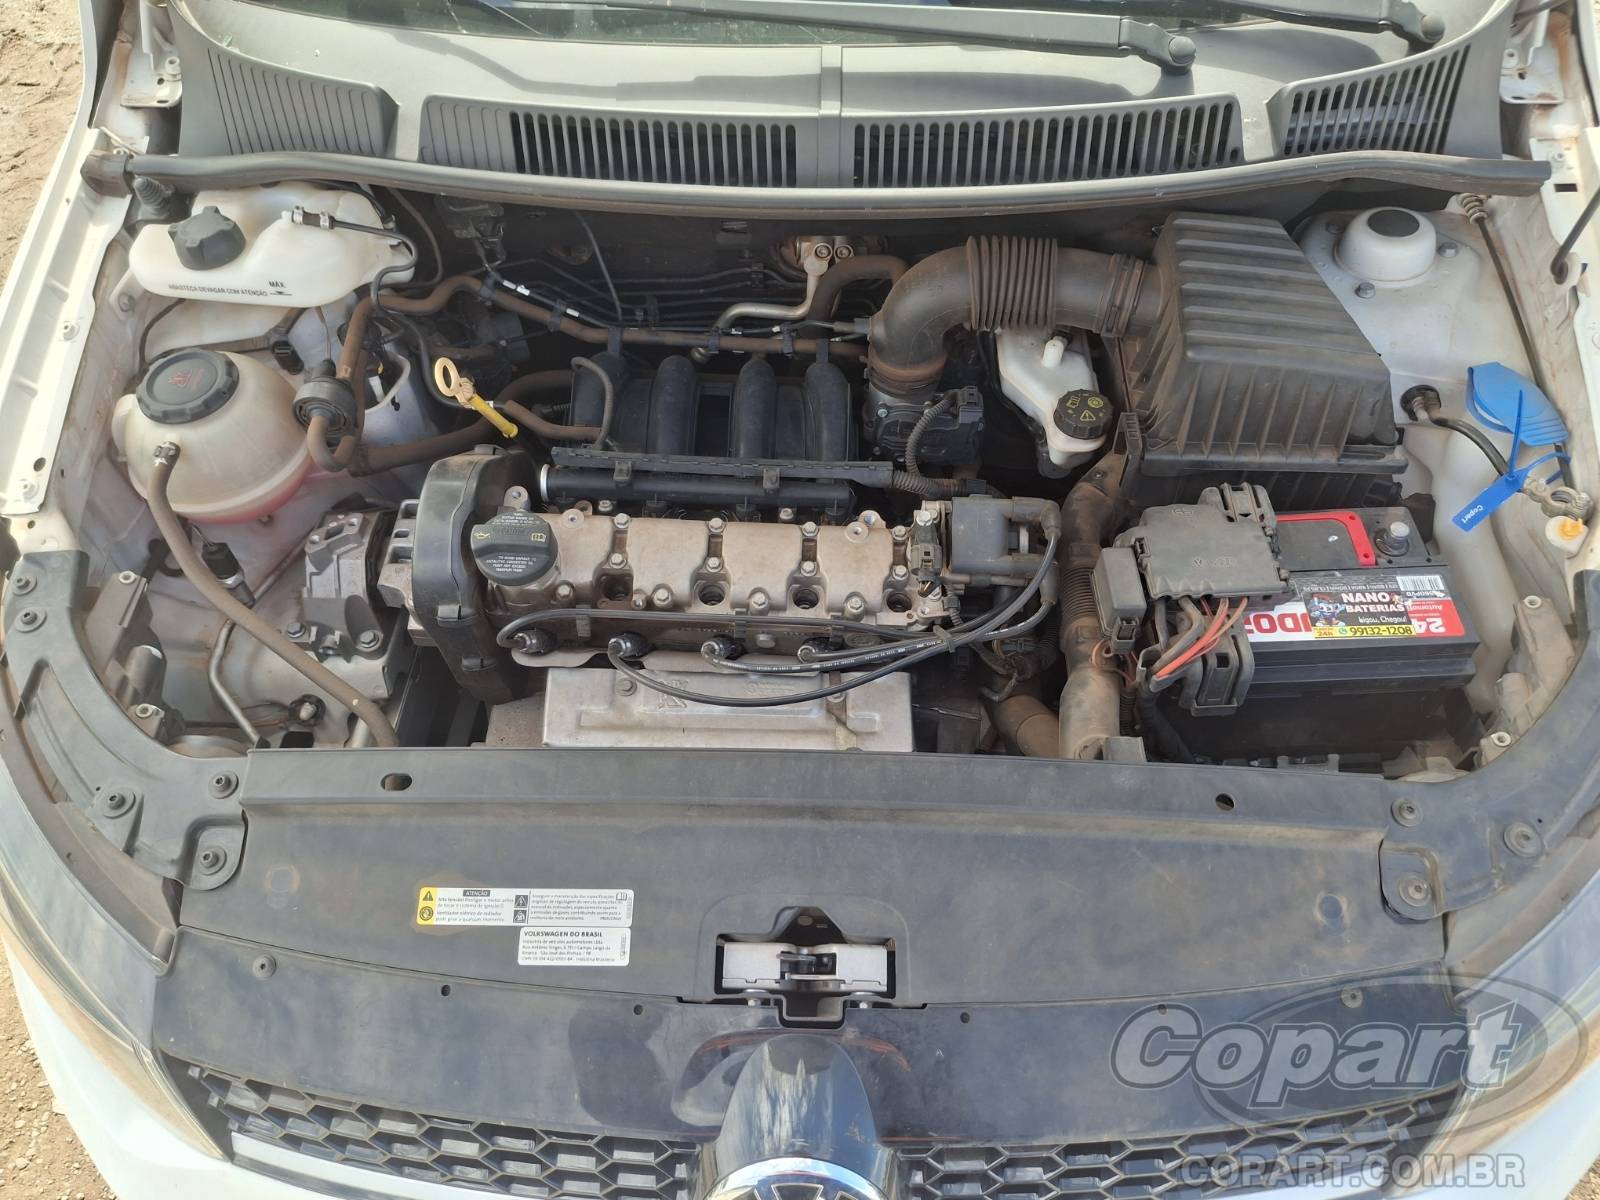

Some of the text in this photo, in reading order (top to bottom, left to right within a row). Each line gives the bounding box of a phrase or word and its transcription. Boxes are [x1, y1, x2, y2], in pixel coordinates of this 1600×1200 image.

[1461, 505, 1484, 523] Copart
[1341, 592, 1391, 603] NANO
[1346, 604, 1406, 613] BATERIAS
[1350, 626, 1413, 636] 99132-1208
